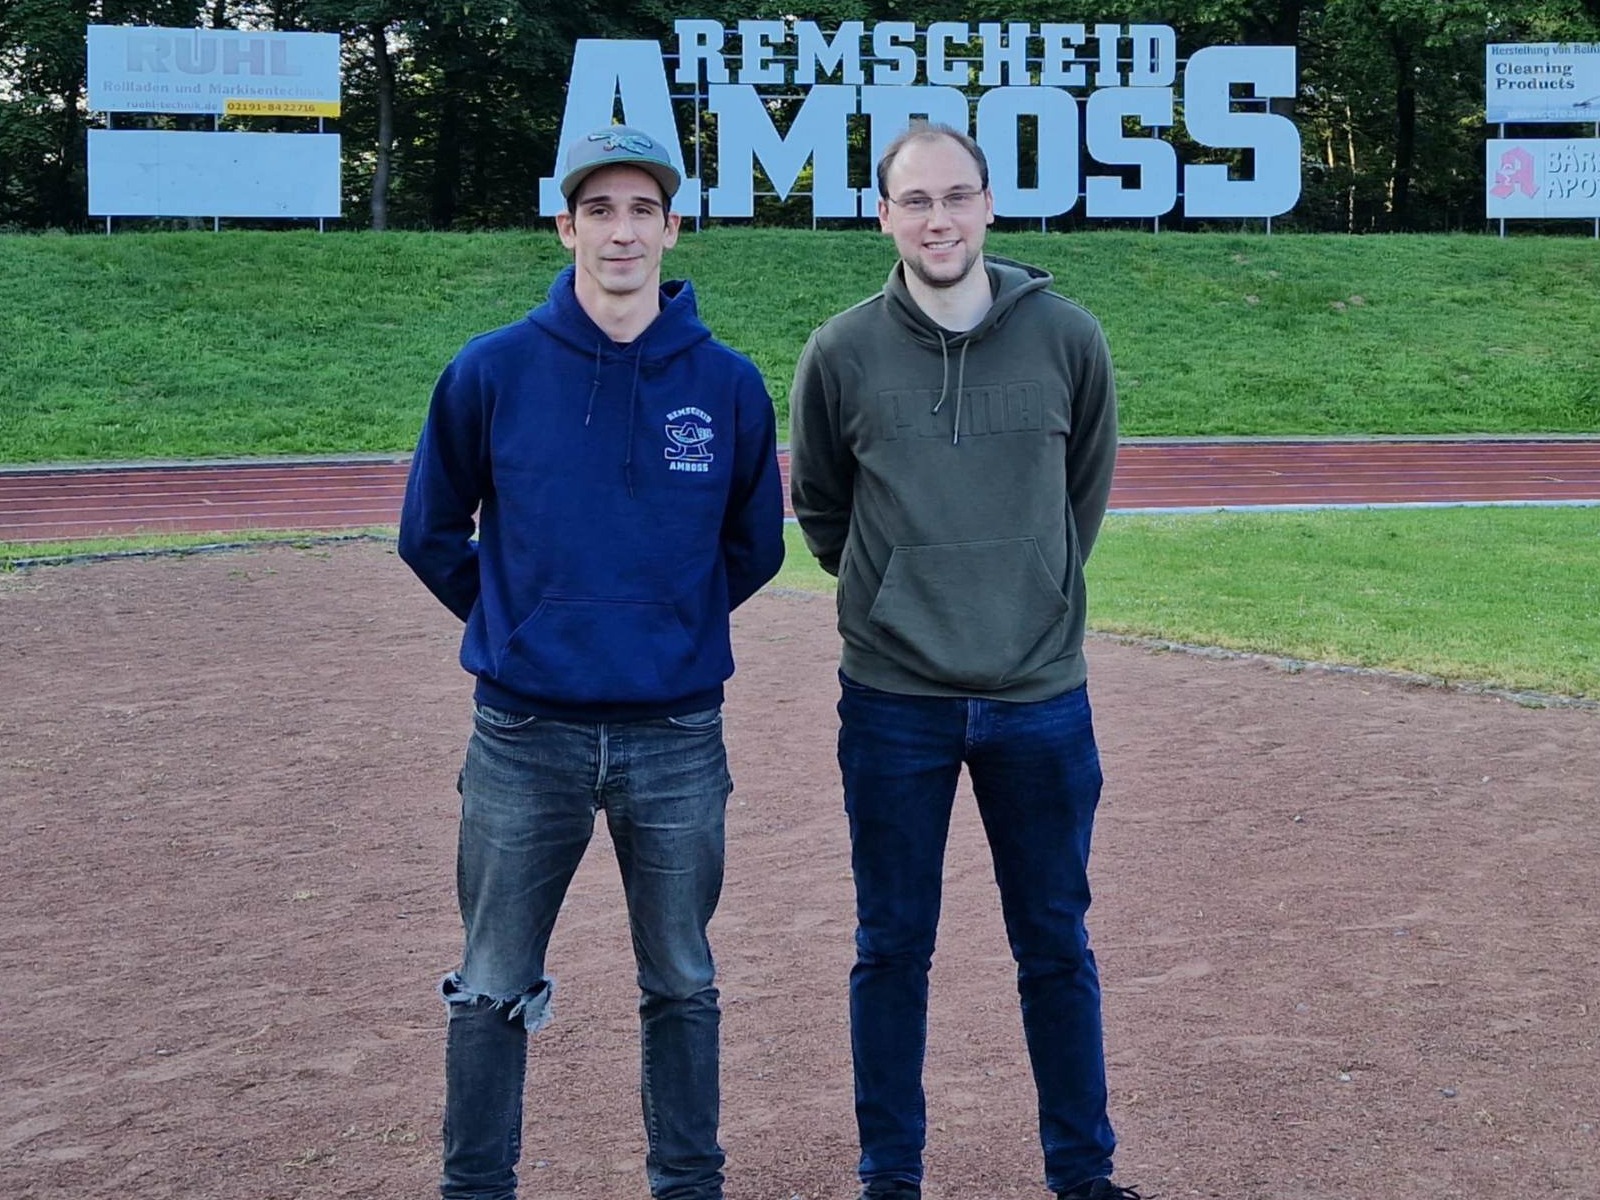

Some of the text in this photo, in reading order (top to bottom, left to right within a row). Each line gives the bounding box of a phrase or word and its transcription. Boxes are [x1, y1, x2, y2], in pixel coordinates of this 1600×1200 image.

[674, 19, 1177, 87] REMSCHEID
[1491, 44, 1549, 57] Herstellung
[1552, 45, 1571, 55] von
[1495, 62, 1574, 76] Cleaning
[175, 82, 202, 94] und
[208, 83, 324, 97] Markisentechnik
[1495, 77, 1575, 90] Products
[226, 101, 316, 113] 02191-8422716
[1548, 144, 1600, 174] BÄR
[1547, 176, 1600, 199] APO
[668, 461, 709, 472] AMBOSS
